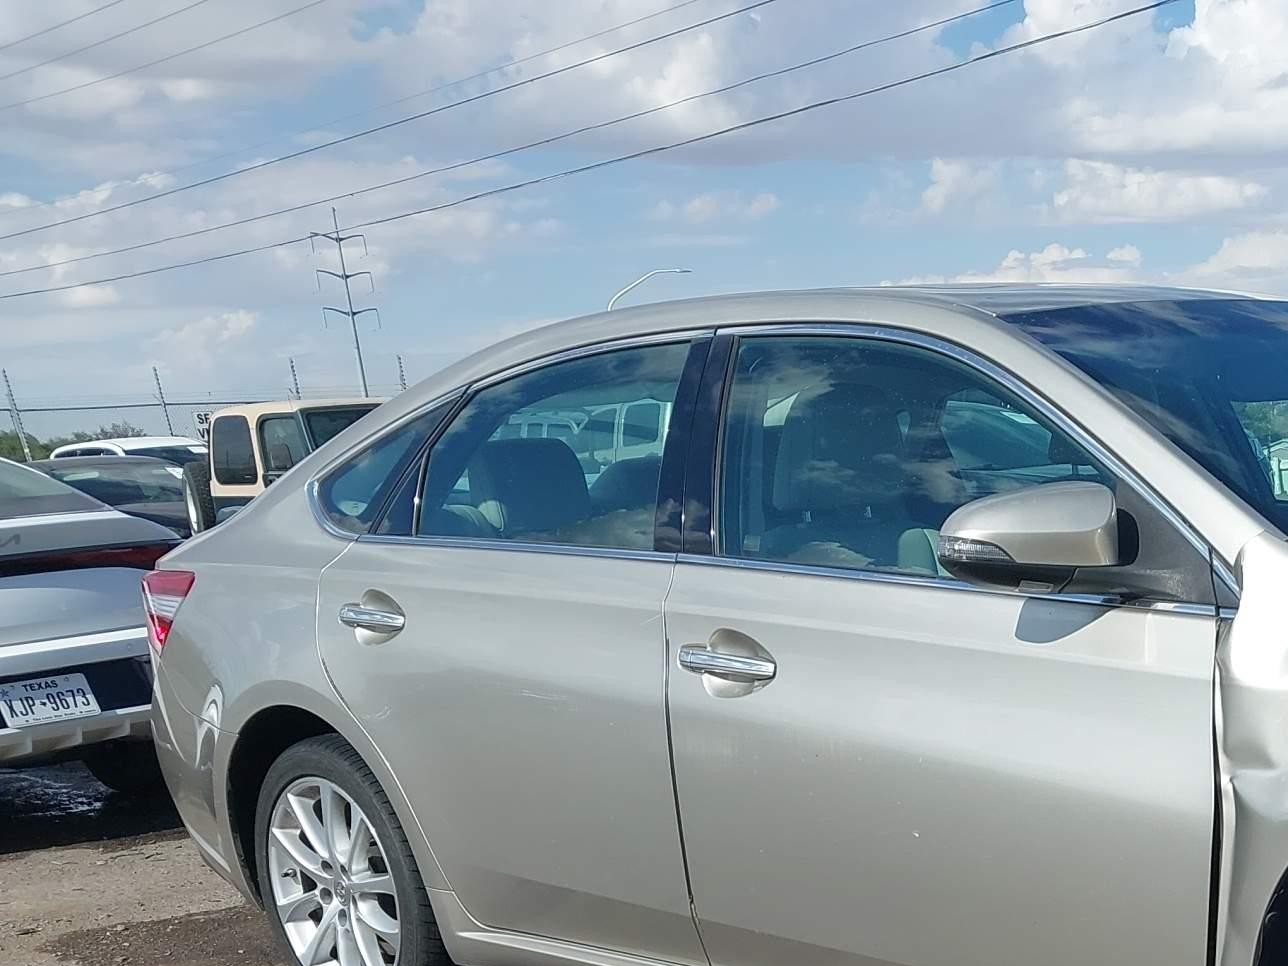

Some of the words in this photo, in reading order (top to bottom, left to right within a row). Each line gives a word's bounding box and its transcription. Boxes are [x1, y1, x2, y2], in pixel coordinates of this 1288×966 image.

[22, 679, 58, 693] TEXAS
[4, 695, 36, 719] XJP
[46, 687, 91, 712] 9673
